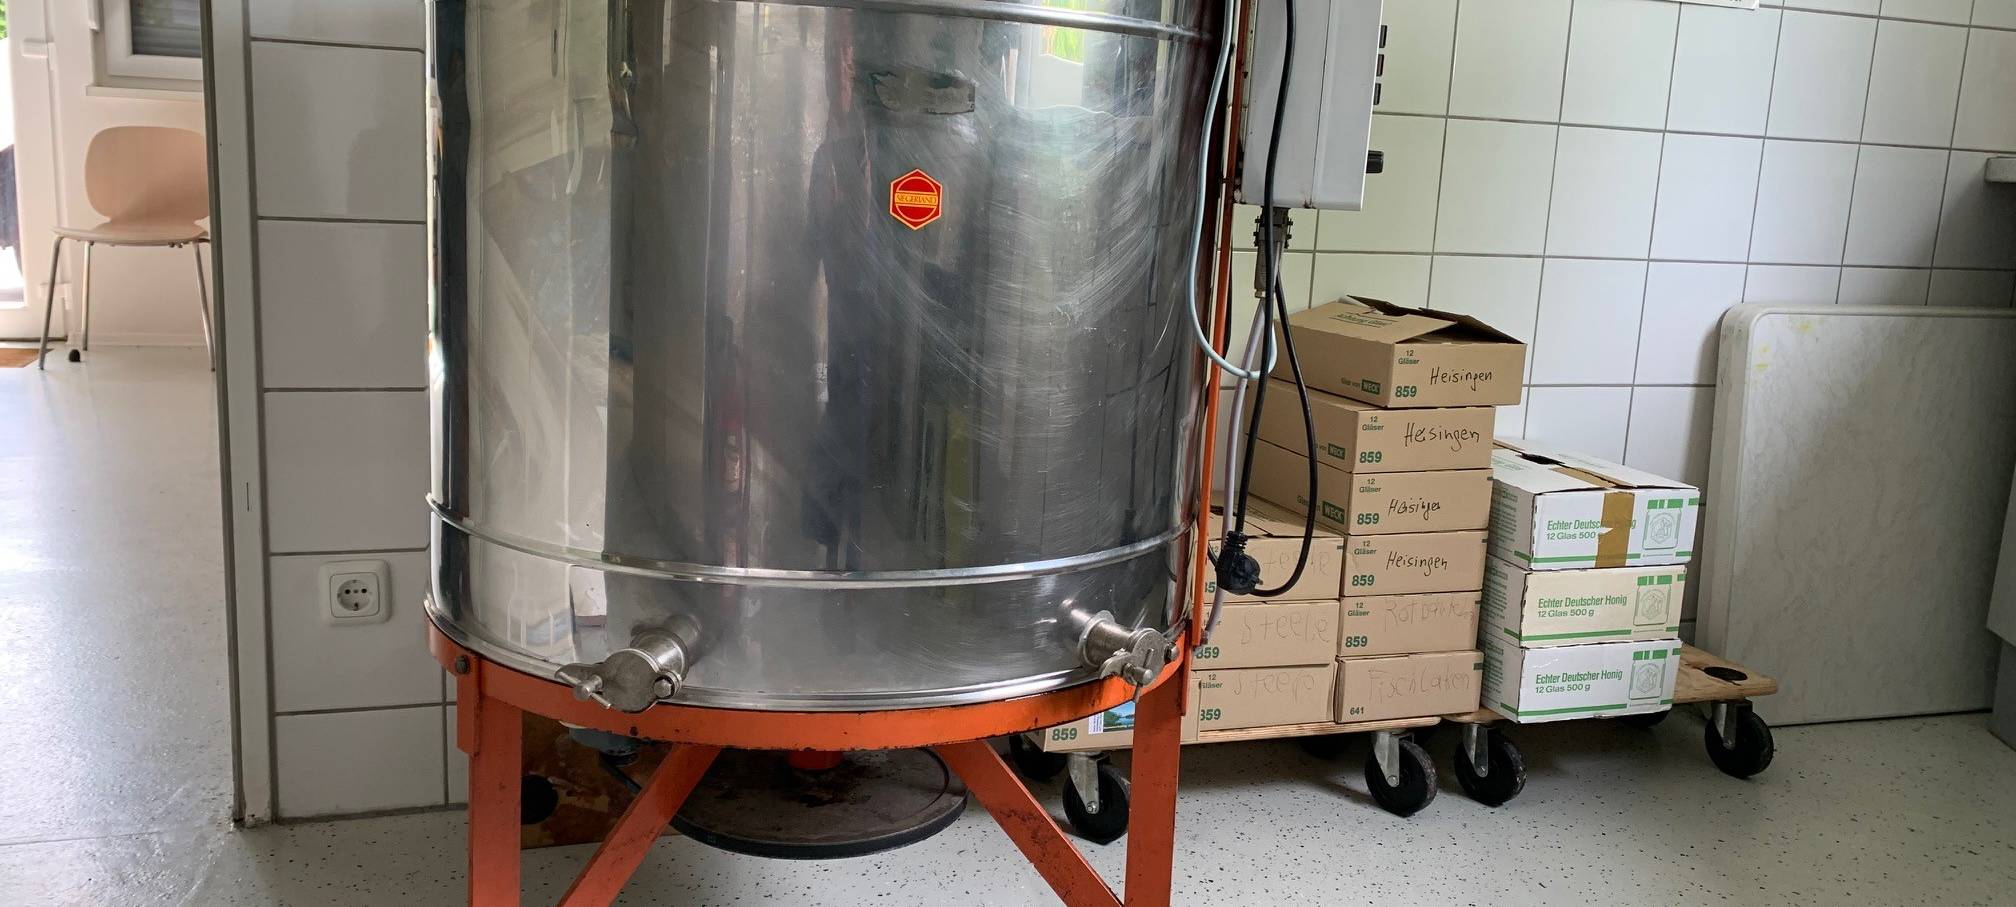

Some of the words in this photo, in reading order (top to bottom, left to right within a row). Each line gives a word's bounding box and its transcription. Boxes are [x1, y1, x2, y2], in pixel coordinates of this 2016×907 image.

[1398, 357, 1420, 365] Gläser
[1430, 366, 1492, 391] Heisingen
[1362, 380, 1379, 393] WECK
[1395, 385, 1417, 398] 859
[1329, 444, 1345, 458] WECK
[1359, 451, 1382, 463] 859
[1324, 502, 1344, 522] WECK
[1357, 513, 1380, 525] 859
[1547, 520, 1573, 531] Echter
[1557, 532, 1577, 540] Glas
[1579, 531, 1596, 539] 500
[1386, 551, 1448, 577] Heisingen
[1352, 574, 1375, 586] 859
[1538, 597, 1563, 608] Echter
[1565, 595, 1604, 607] Deutscher
[1605, 594, 1628, 606] Honig
[1548, 609, 1568, 617] Glas
[1570, 608, 1587, 616] 500
[1589, 609, 1595, 617] g
[1345, 635, 1368, 648] 859
[1535, 673, 1561, 685] Echter
[1562, 671, 1600, 683] Deutscher
[1600, 669, 1623, 681] Honig
[1545, 685, 1565, 693] Glas
[1567, 684, 1583, 692] 500
[1585, 684, 1590, 692] g
[1349, 707, 1364, 716] 641
[1051, 727, 1077, 741] 859
